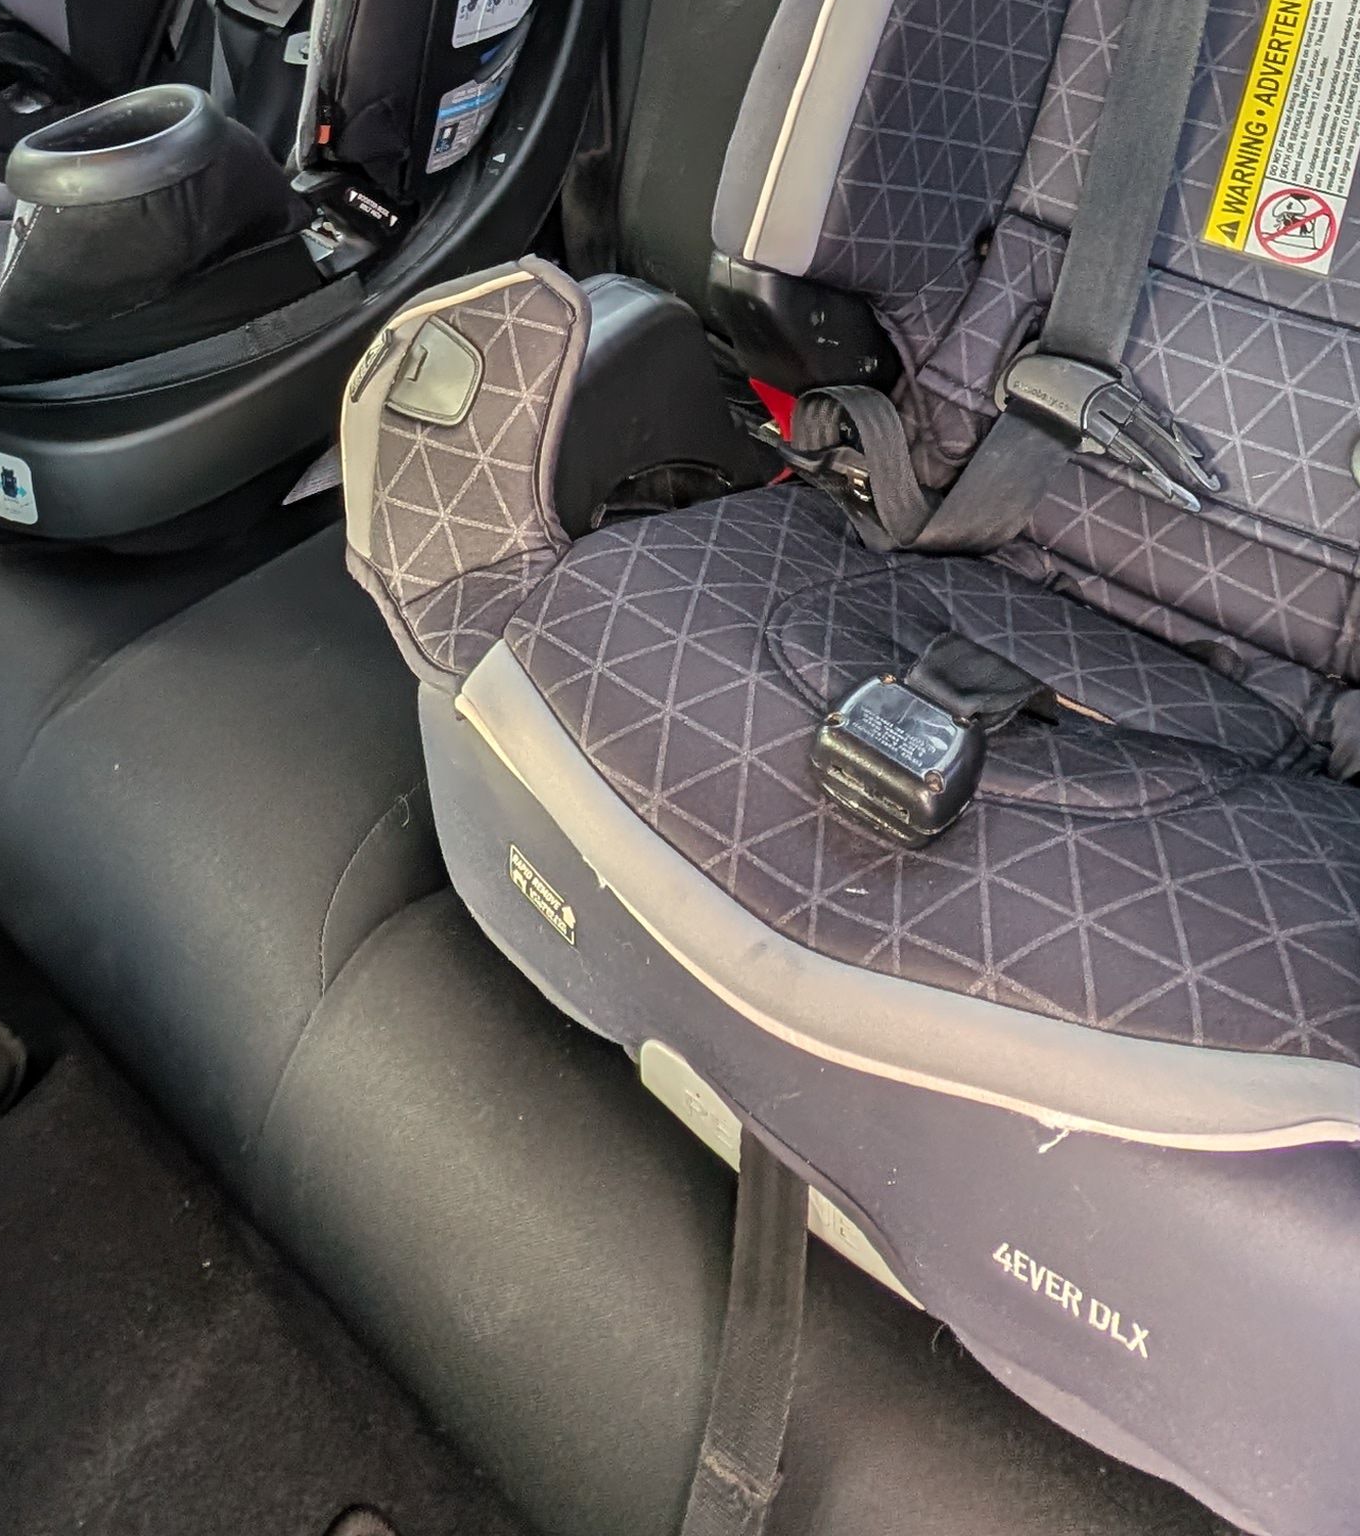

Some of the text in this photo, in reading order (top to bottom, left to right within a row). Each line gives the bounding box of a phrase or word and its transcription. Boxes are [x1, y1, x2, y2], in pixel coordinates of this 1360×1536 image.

[1272, 148, 1282, 163] NOT
[1277, 128, 1288, 147] place
[1292, 74, 1302, 90] child
[1303, 31, 1313, 47] front
[1309, 15, 1317, 30] seat
[1279, 153, 1292, 178] DEATH
[1289, 109, 1303, 141] SERIOUS
[1297, 82, 1311, 108] INJURY
[1334, 126, 1347, 155] MUERTE
[1343, 83, 1358, 118] LESIONES
[1222, 119, 1267, 216] WARNING
[992, 1242, 1150, 1360] 4EVER DLX
